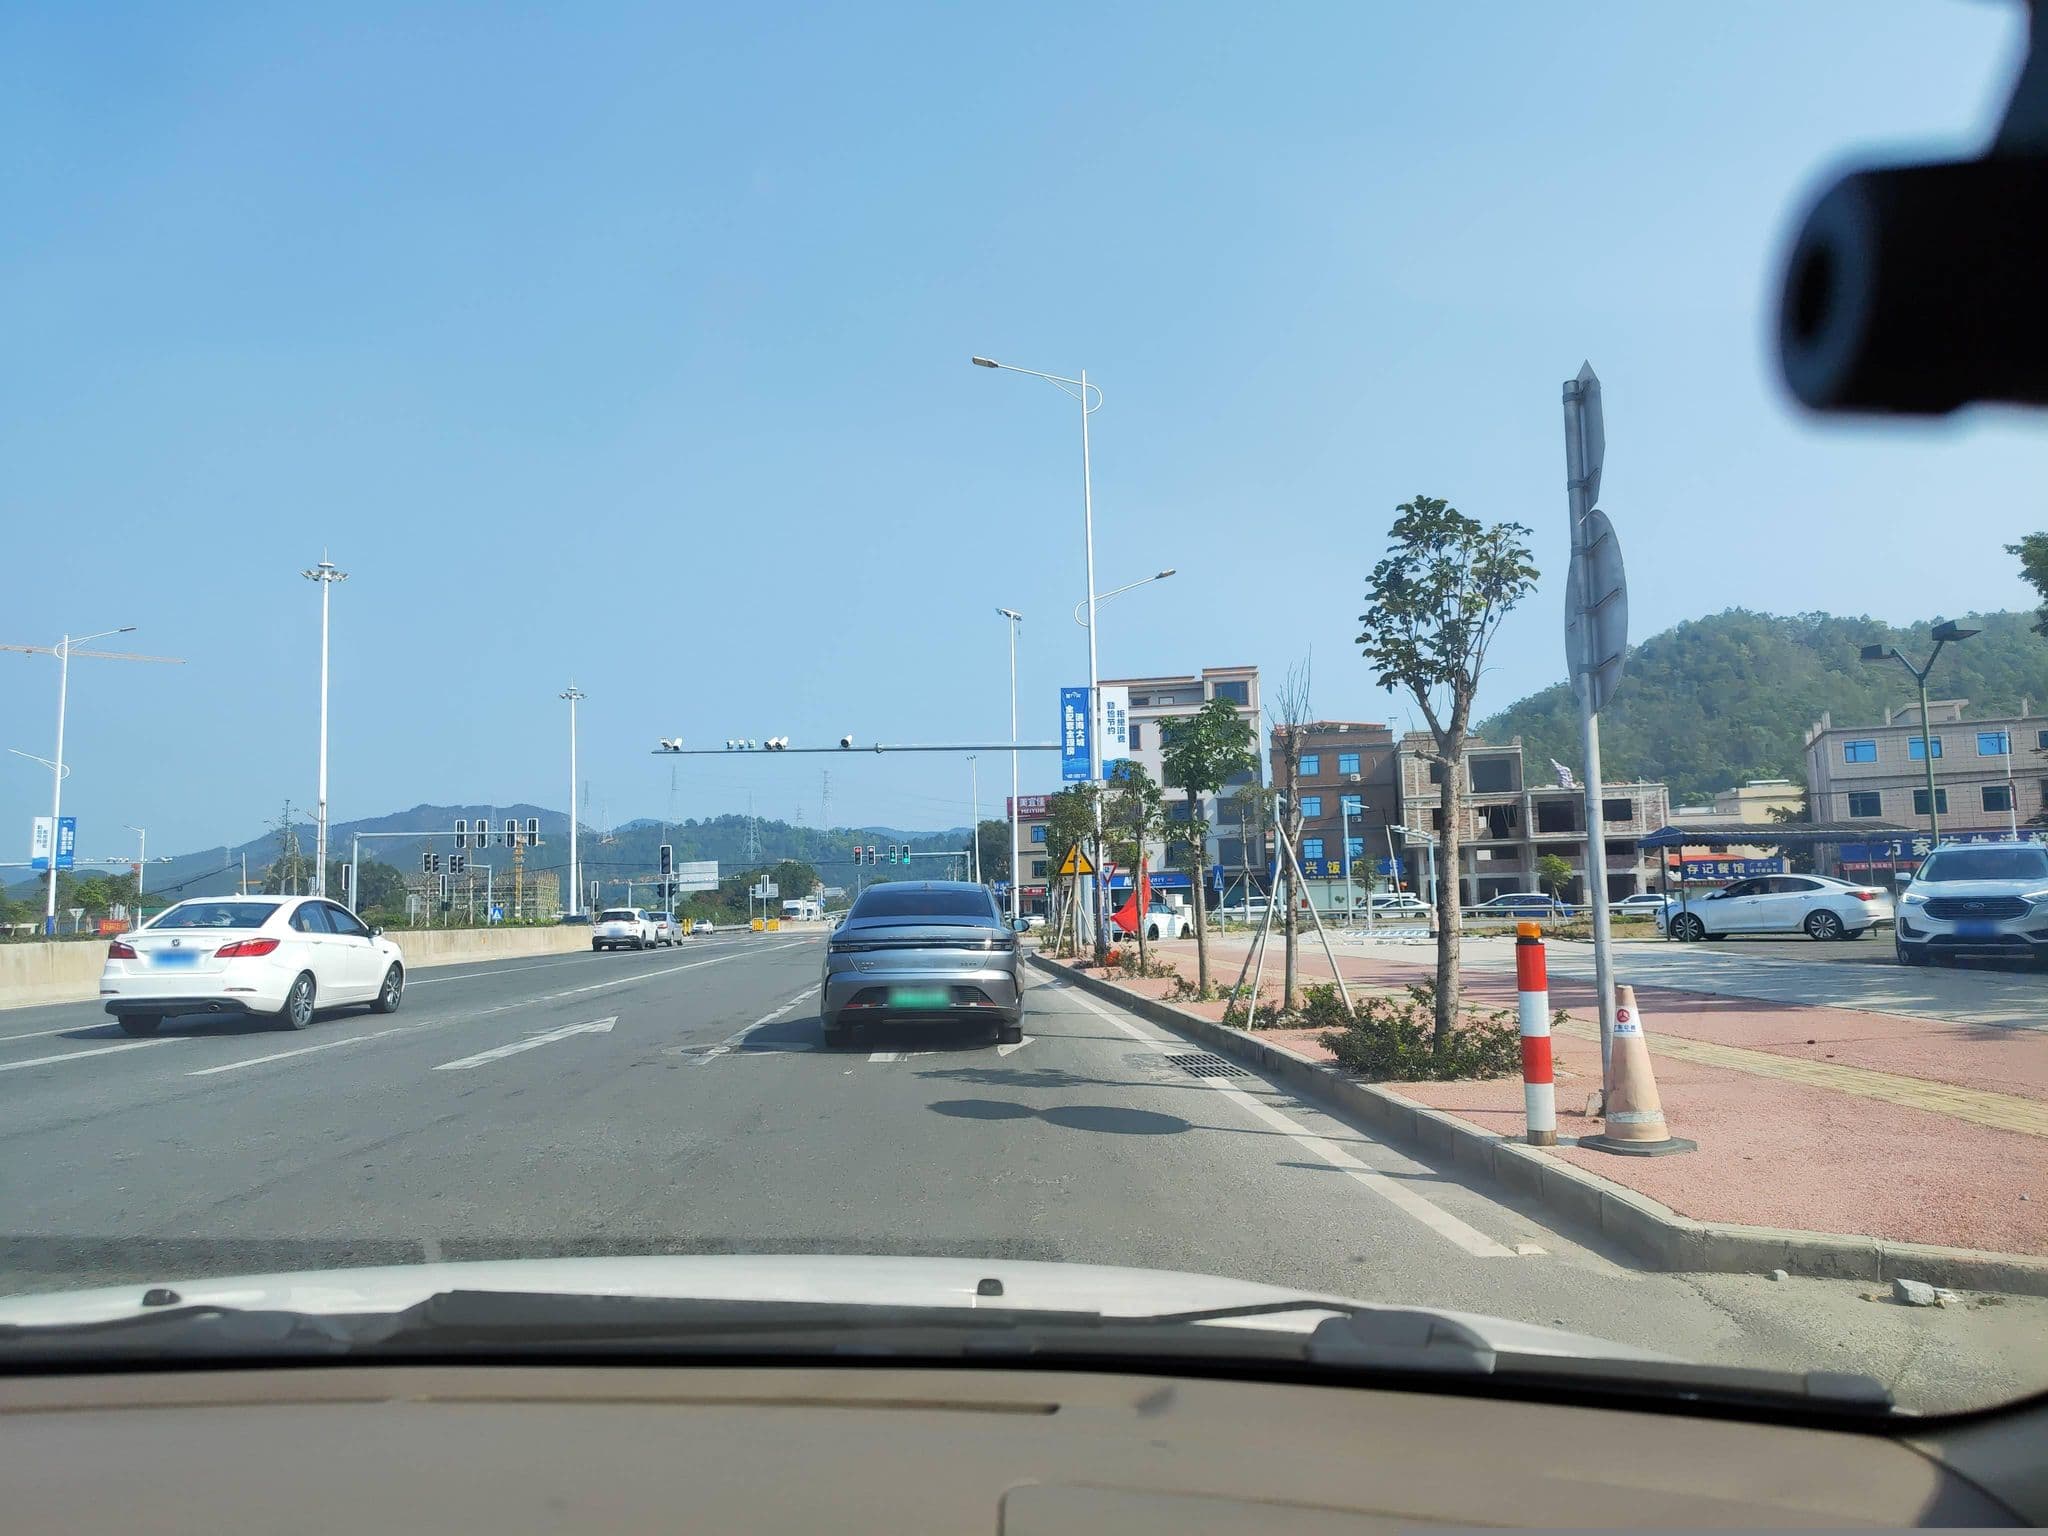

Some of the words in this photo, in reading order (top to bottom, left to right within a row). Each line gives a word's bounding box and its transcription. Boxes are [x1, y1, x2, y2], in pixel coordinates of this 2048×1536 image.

[1107, 702, 1116, 735] 勤俭节约
[1117, 709, 1126, 743] 拒绝浪费
[1686, 862, 1746, 875] 存记餐馆
